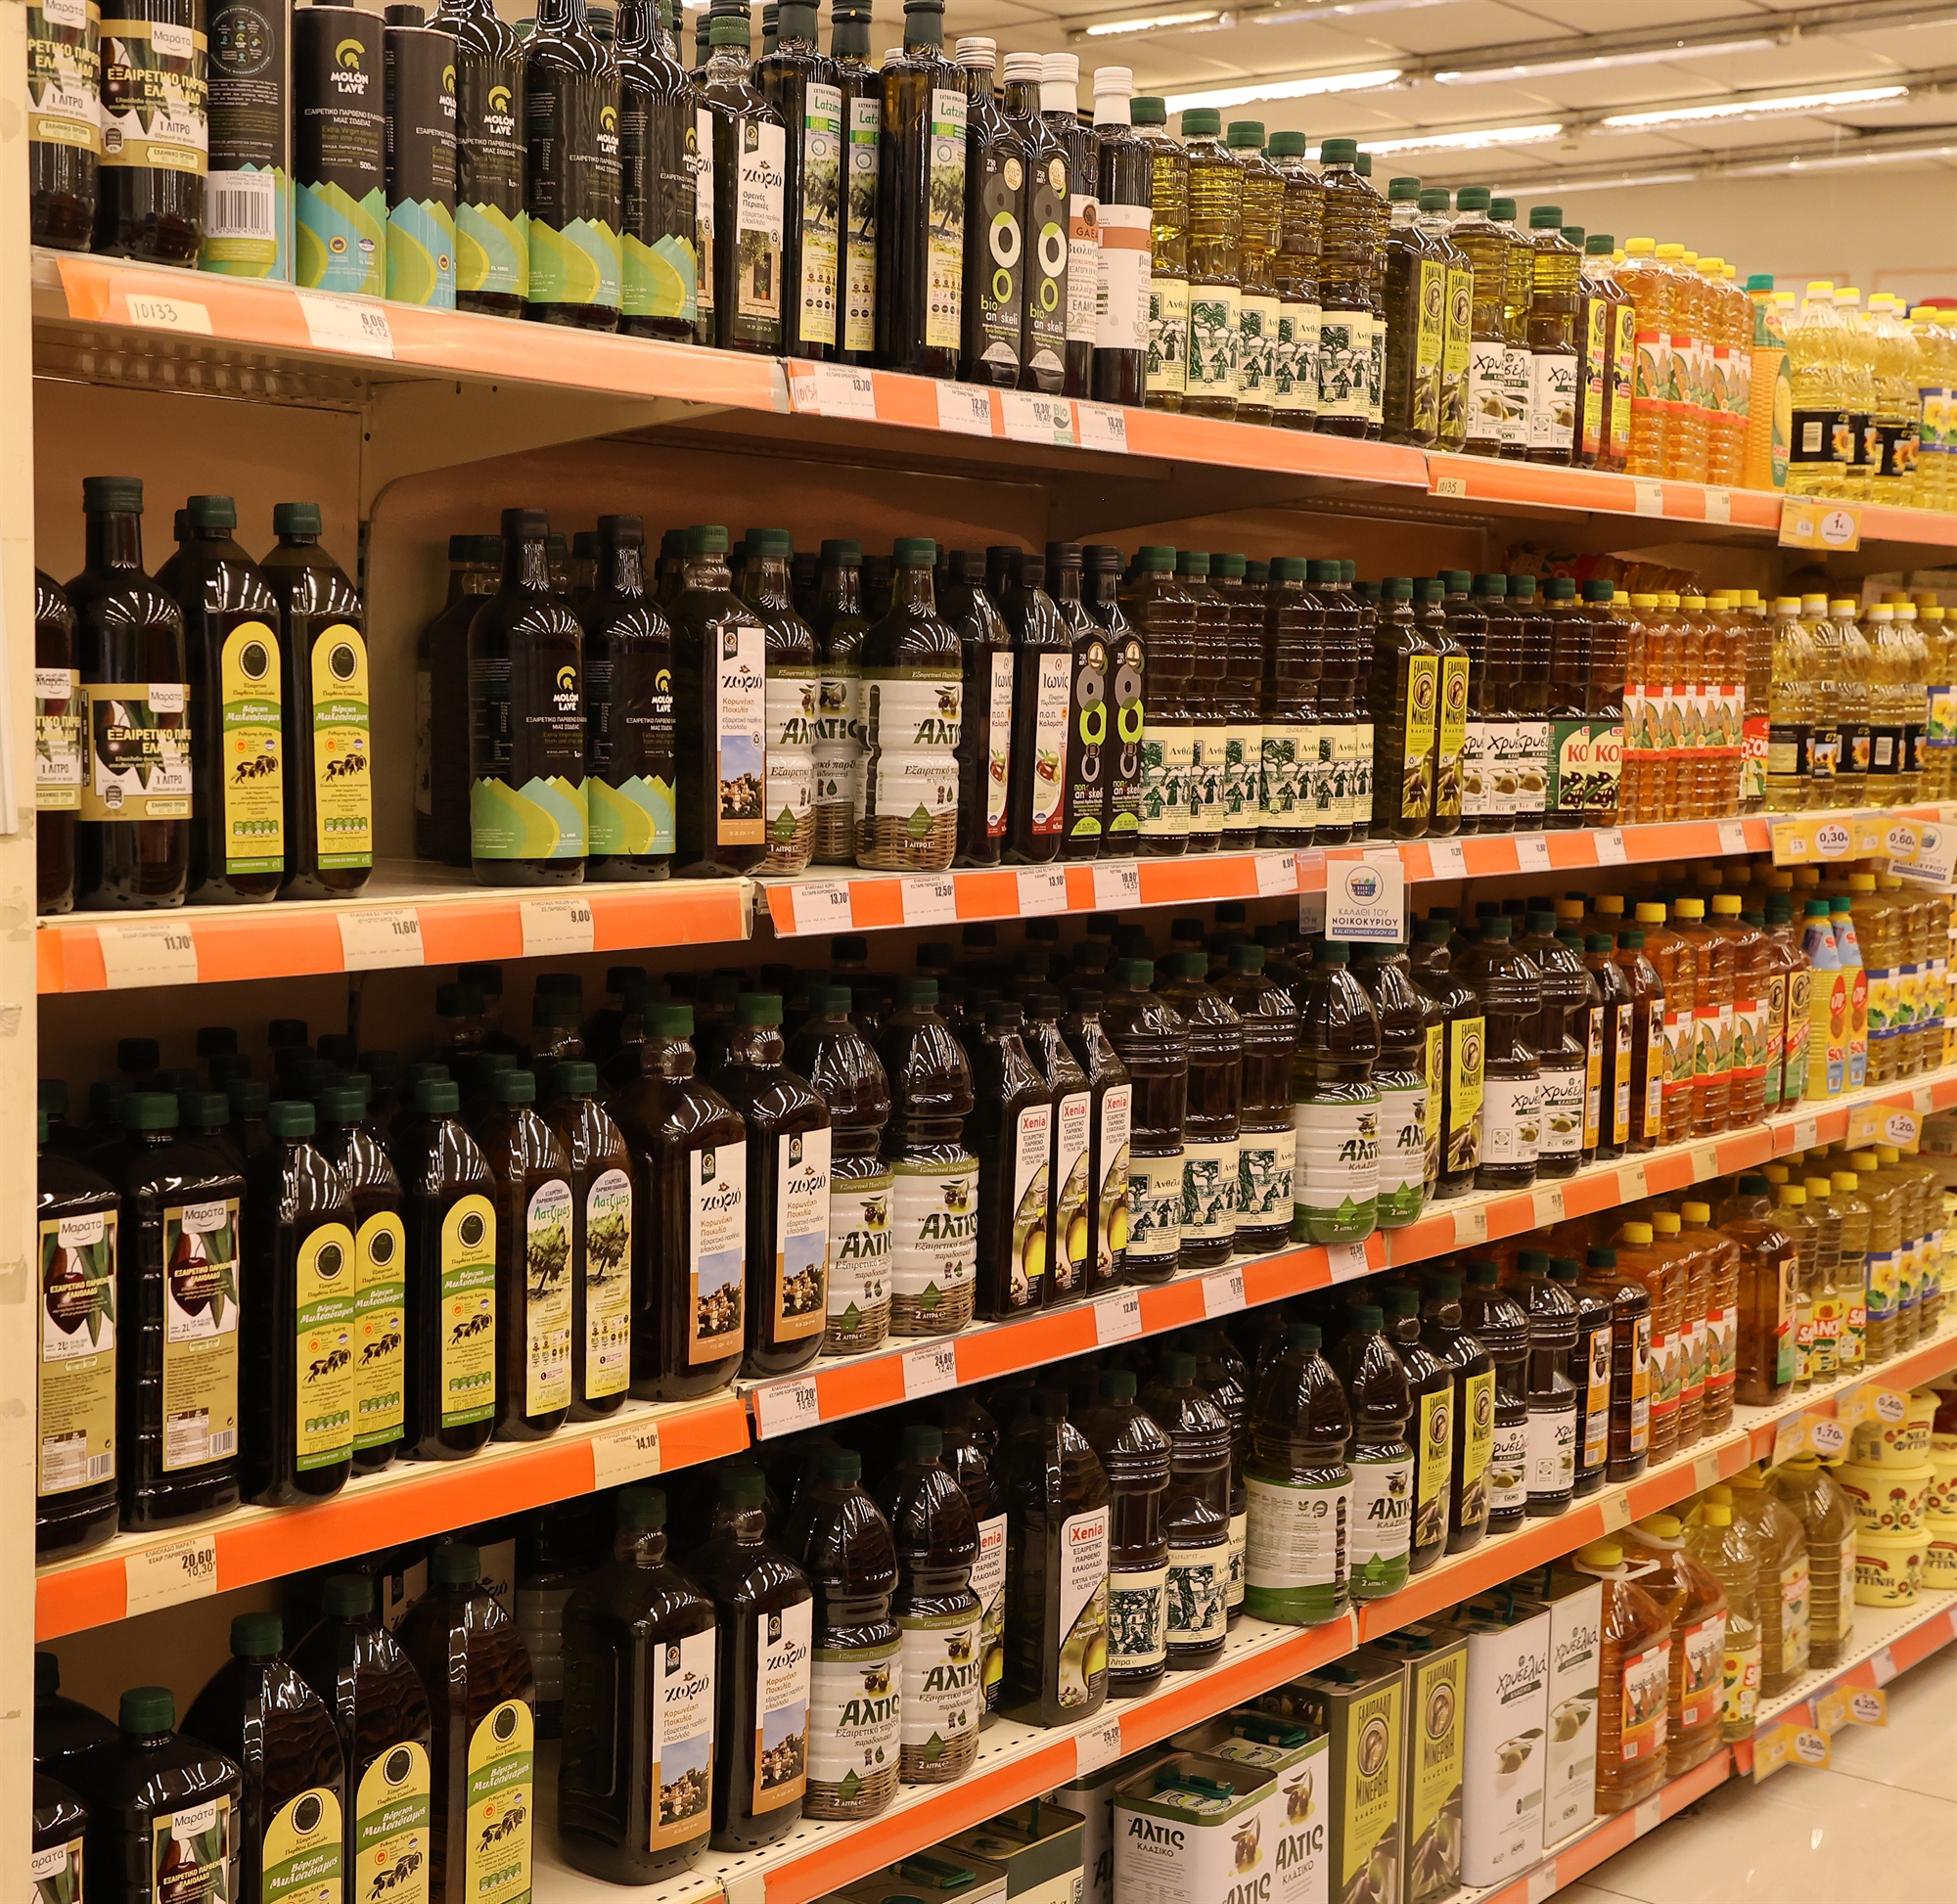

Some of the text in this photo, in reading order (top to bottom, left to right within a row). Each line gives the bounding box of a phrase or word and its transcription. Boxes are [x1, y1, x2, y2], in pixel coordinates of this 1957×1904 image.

[154, 30, 191, 51] Μαράτα
[133, 302, 178, 324] 10133
[1338, 908, 1389, 917] ΚΑΛΑΘΙ ΤΟΥ
[1332, 917, 1398, 927] ΝΟΙΚΟΚΥΡΙΟΥ
[1064, 1104, 1085, 1116] Xenia
[1107, 1097, 1126, 1111] Xenia
[1023, 1115, 1046, 1129] Xenia
[1071, 1523, 1103, 1542] Xenia
[174, 1806, 215, 1828] Μαράτα
[1137, 1841, 1174, 1859] ΚΛΑΣΙΚΟ
[1282, 1861, 1314, 1886] ΚΛΑΣΙΚΟ
